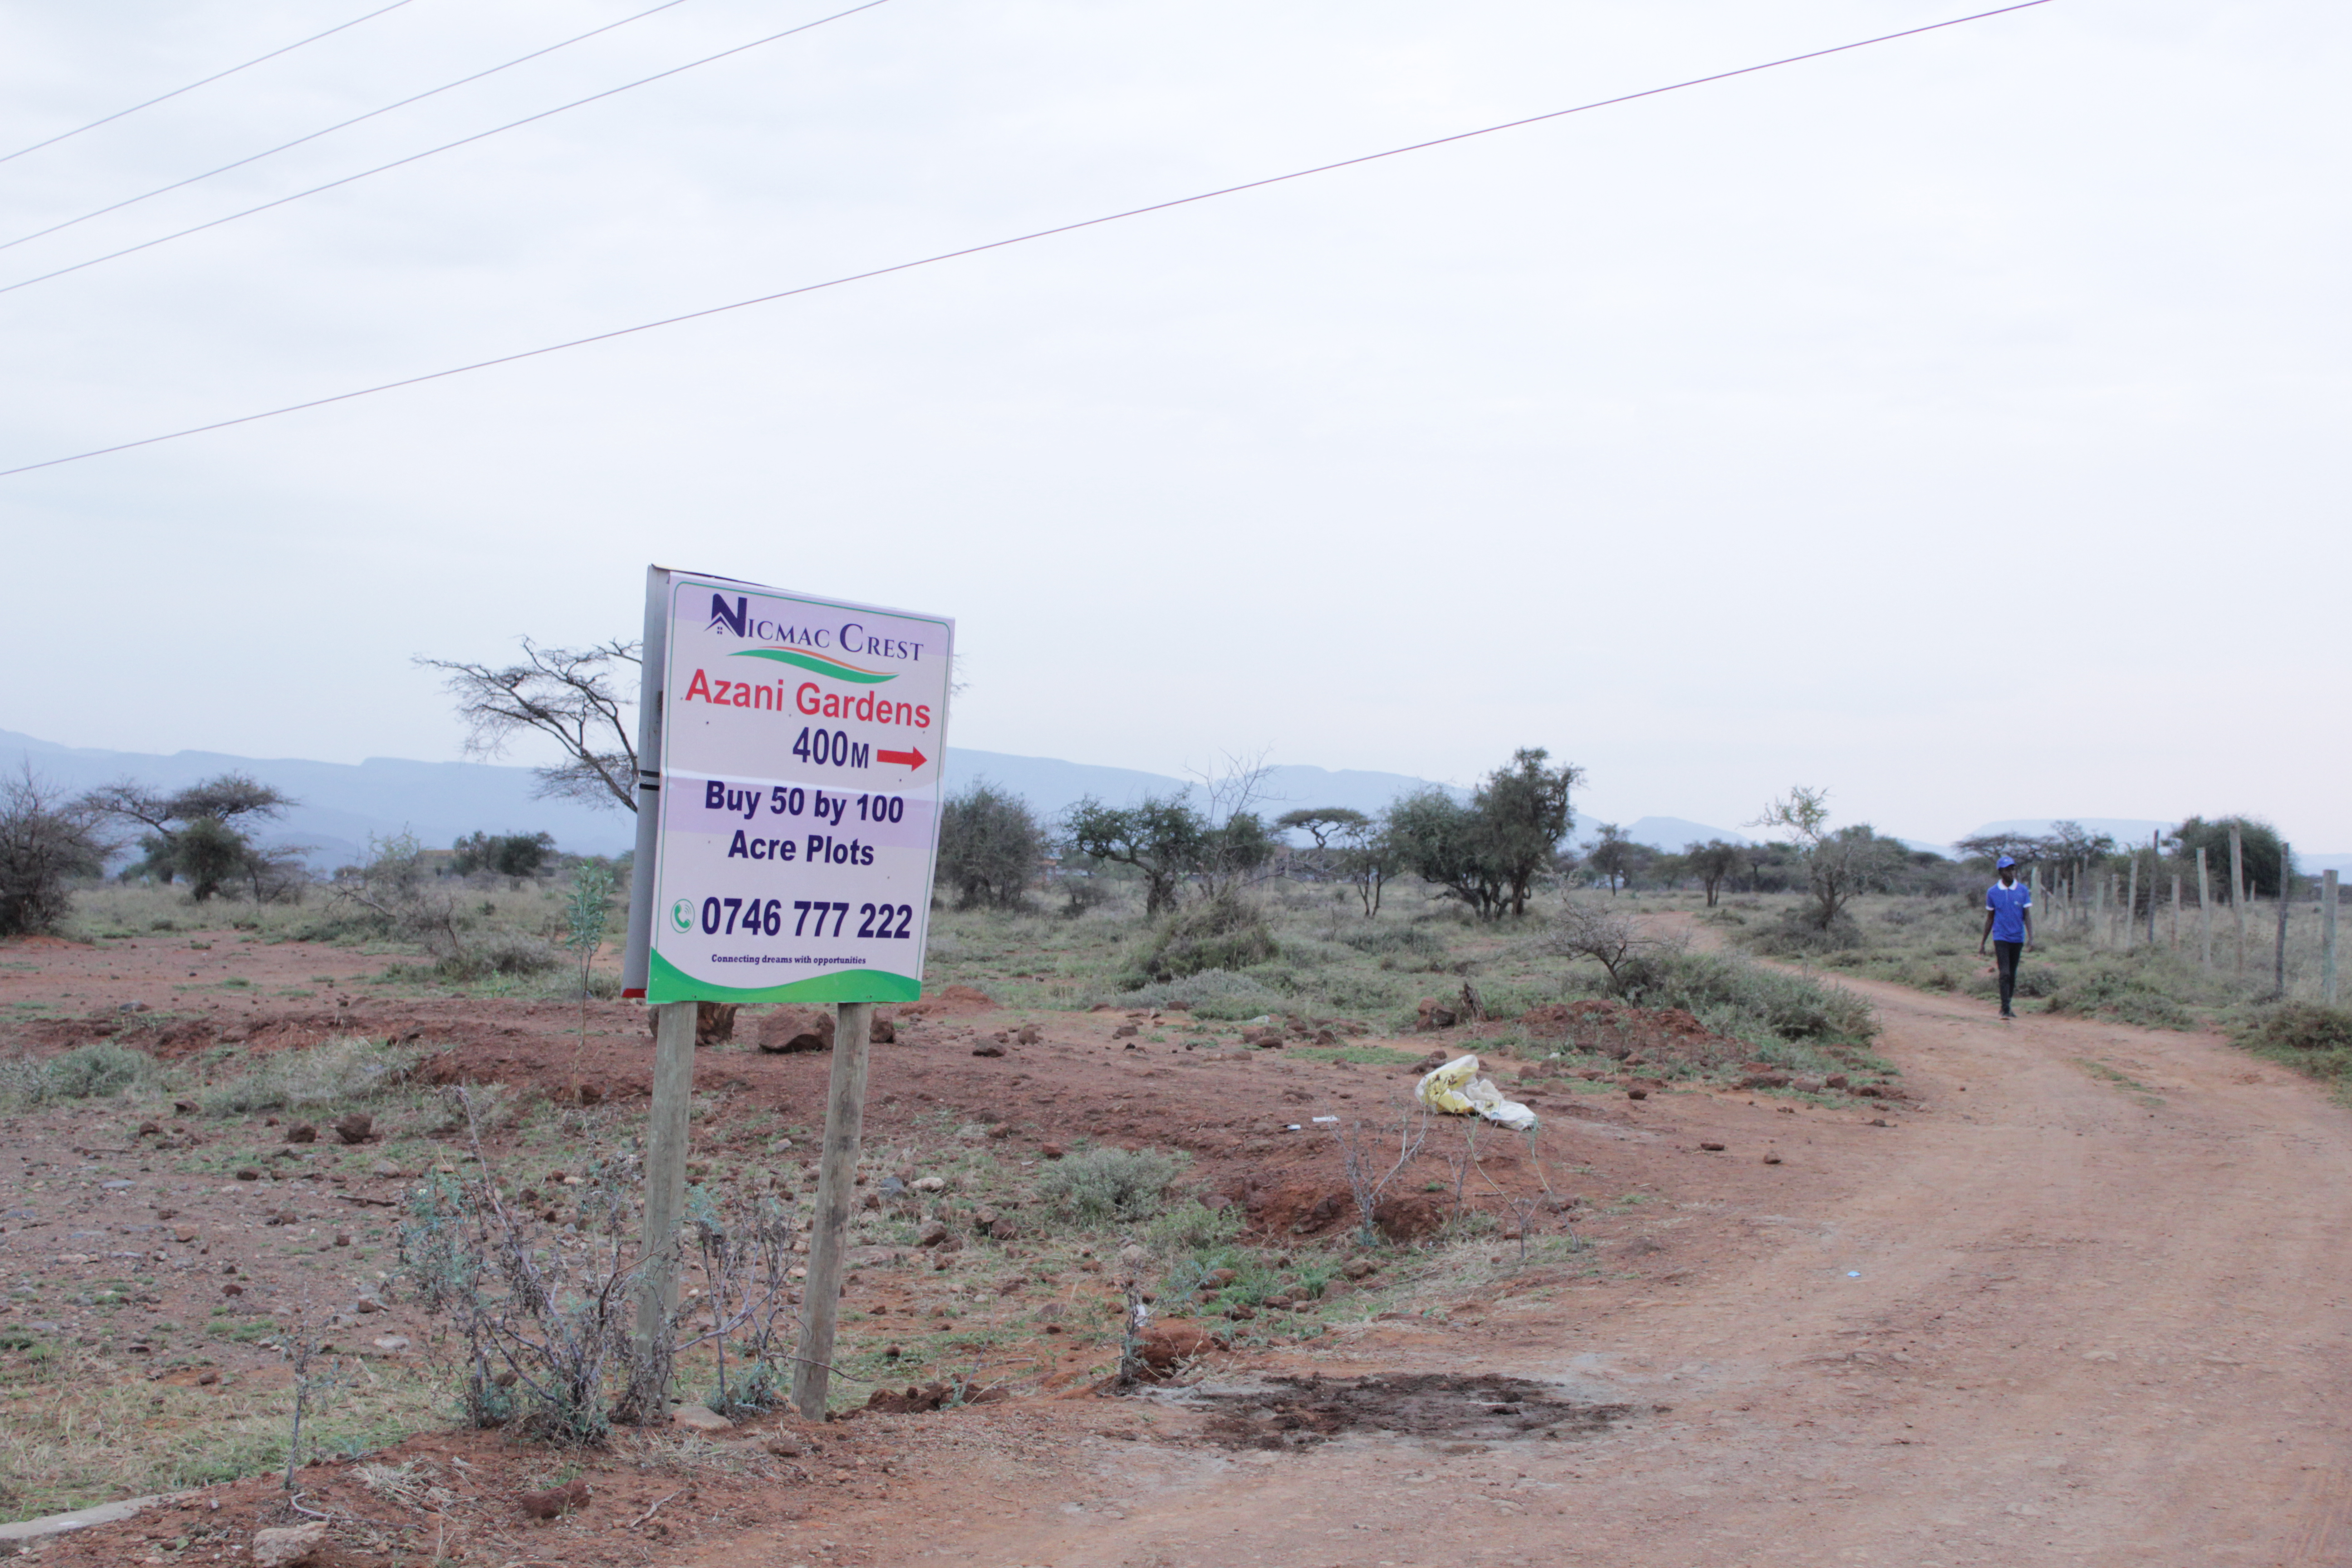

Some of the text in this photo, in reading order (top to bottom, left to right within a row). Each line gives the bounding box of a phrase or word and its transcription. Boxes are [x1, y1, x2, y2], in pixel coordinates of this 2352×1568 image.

[706, 593, 924, 662] NICMAC CREST
[685, 668, 931, 729] Azani Gardens
[705, 780, 904, 827] Buy 50 by 100
[727, 829, 874, 866] Acre Plots
[701, 896, 913, 939] 0746 777 222
[711, 953, 867, 966] Connecting dreams with opportunities
